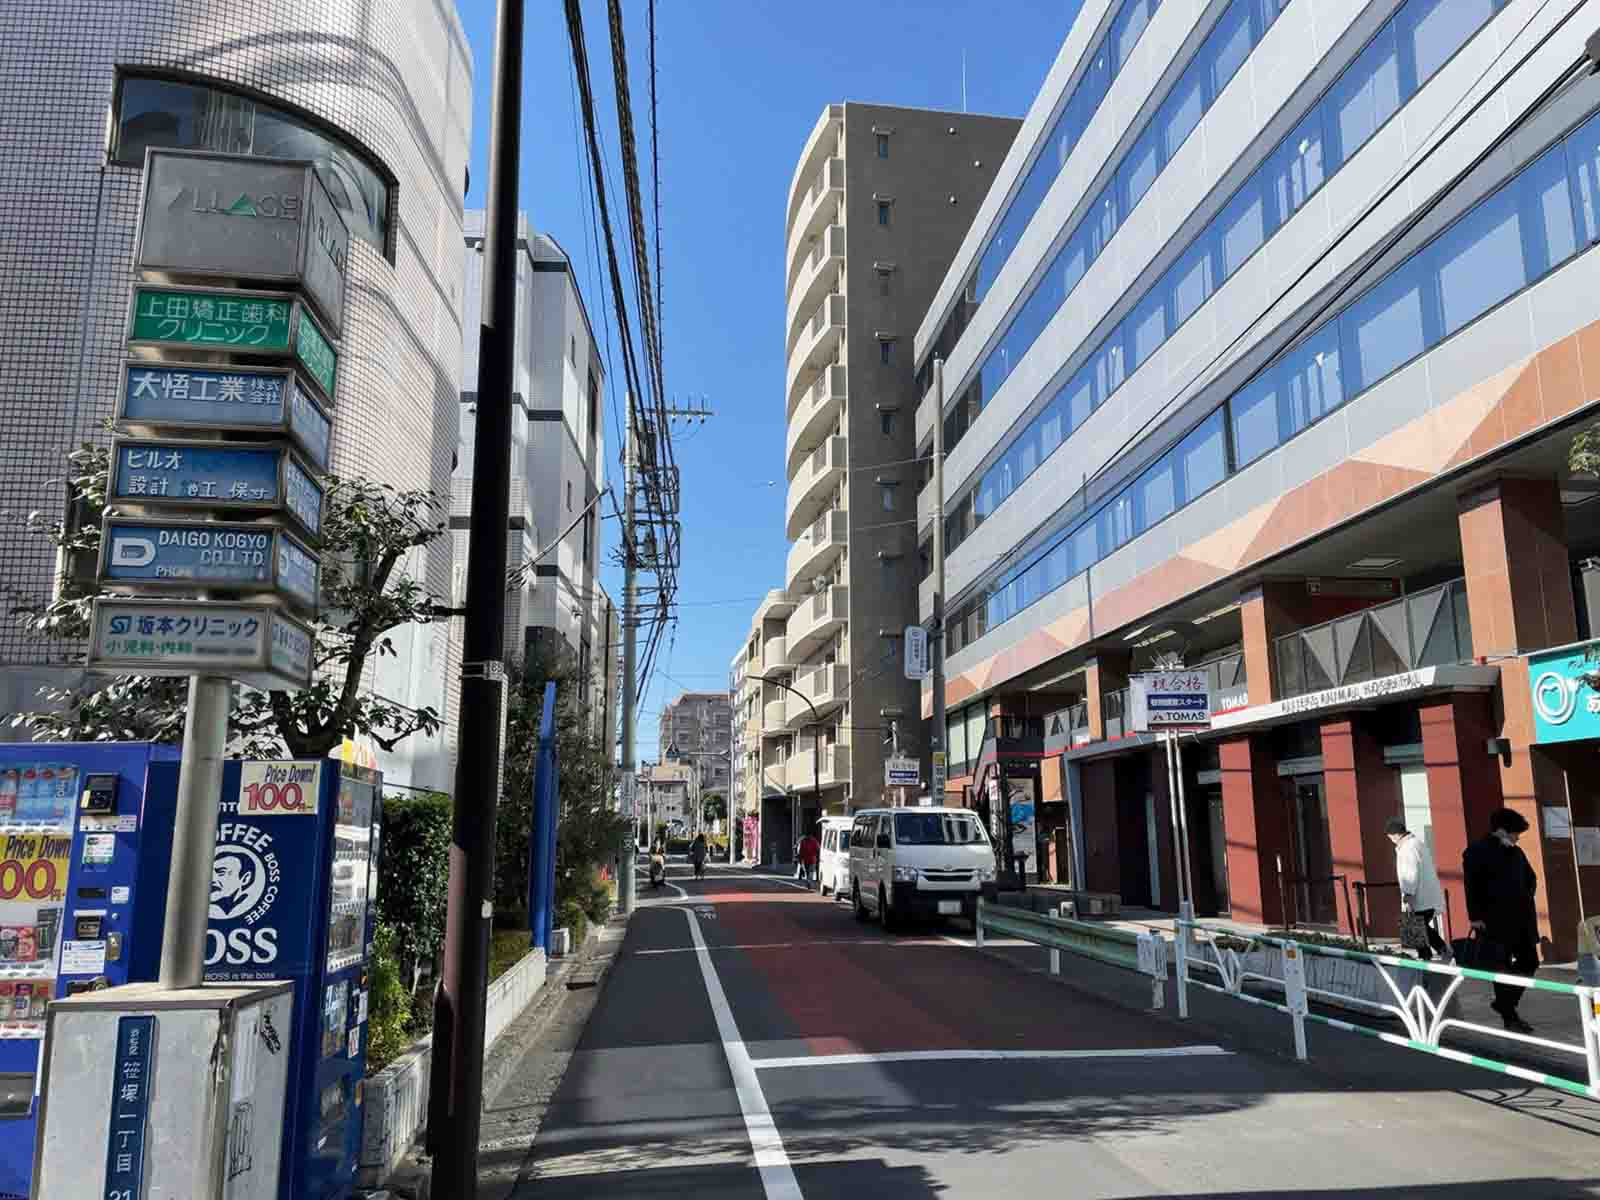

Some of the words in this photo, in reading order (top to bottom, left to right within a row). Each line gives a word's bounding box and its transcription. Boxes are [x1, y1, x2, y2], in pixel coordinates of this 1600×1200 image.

[157, 319, 270, 344] クリニック
[132, 372, 246, 402] 大悟工業
[159, 530, 210, 547] DAIGO
[214, 533, 267, 549] KOGYO
[1221, 692, 1248, 710] TOMAS
[1166, 712, 1205, 720] TOMAS
[265, 764, 287, 783] Price
[243, 782, 303, 811] 100
[4, 835, 35, 859] Price
[264, 853, 280, 883] BOSS
[245, 886, 279, 926] COFFEE
[203, 928, 278, 965] OSS
